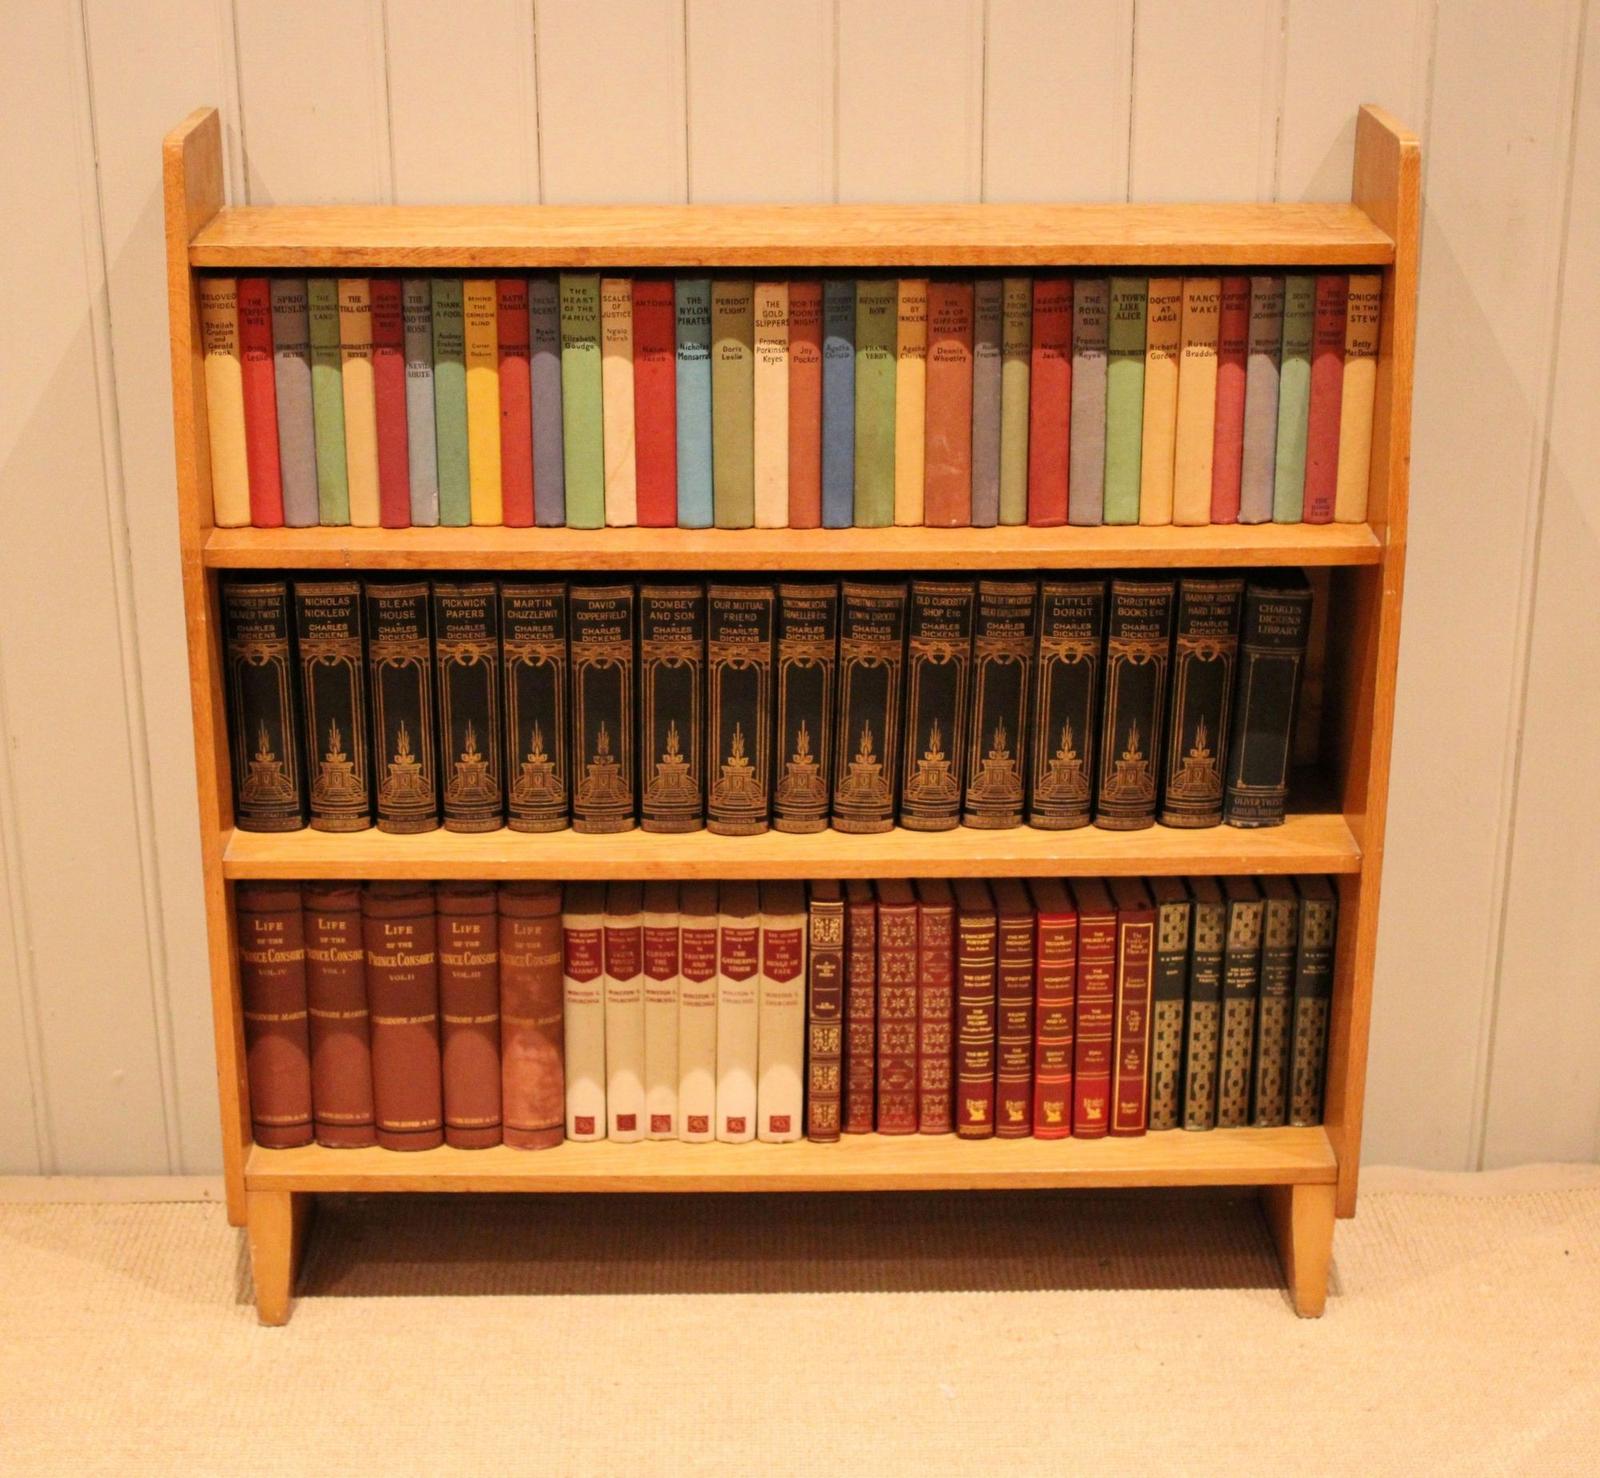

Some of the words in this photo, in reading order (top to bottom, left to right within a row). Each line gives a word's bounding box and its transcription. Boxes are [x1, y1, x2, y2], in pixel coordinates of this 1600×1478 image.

[1189, 294, 1221, 302] NANCY
[762, 309, 784, 318] GOLD
[1350, 314, 1378, 323] STEW
[304, 596, 350, 606] NICHOLAS
[379, 599, 416, 609] BLEAK
[441, 598, 487, 608] PICKWICK
[513, 598, 552, 608] MARTIN
[587, 599, 616, 609] DAVID
[650, 600, 695, 609] DOMBEY
[713, 600, 731, 609] OUR
[1054, 596, 1093, 606] LITTLE
[1117, 596, 1166, 607] CHRISTMAS
[304, 607, 351, 618] NICKLEBY
[379, 609, 416, 620] HOUSE
[445, 609, 485, 618] PAPERS
[649, 610, 670, 620] AND
[674, 610, 696, 620] SON
[722, 612, 758, 621] FRIEND
[1053, 607, 1093, 617] DORRIT
[1117, 607, 1148, 617] BOOKS
